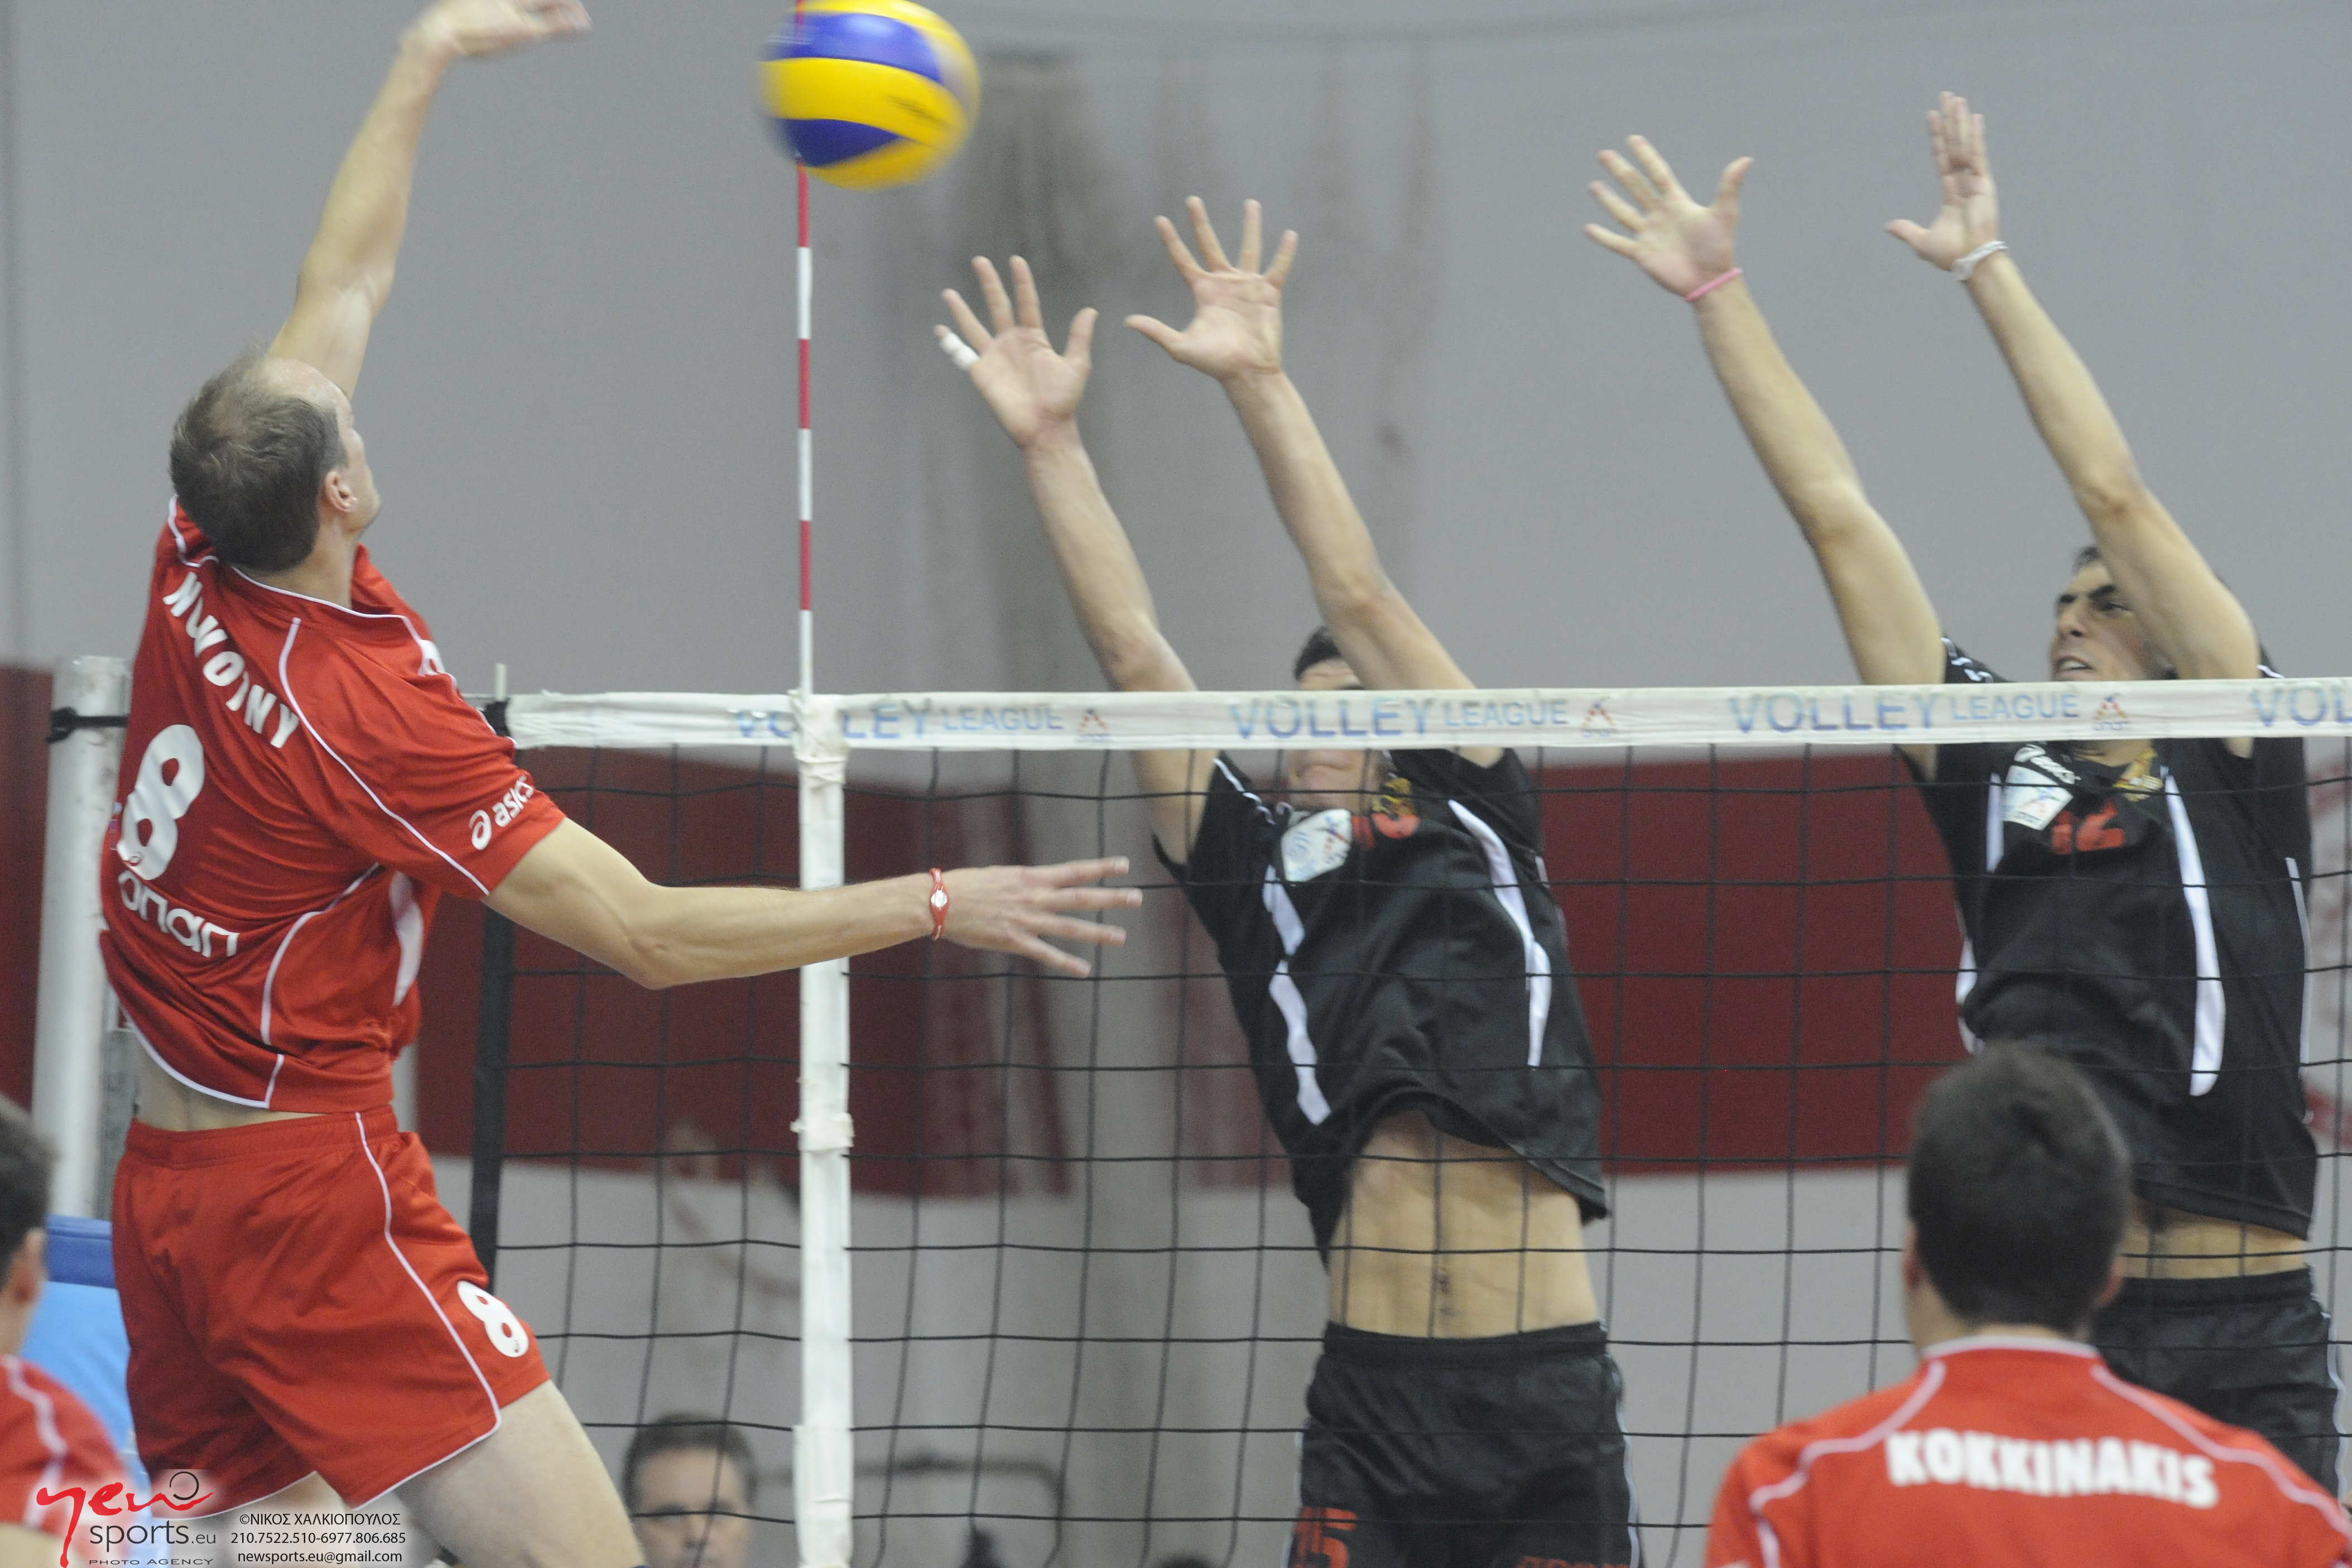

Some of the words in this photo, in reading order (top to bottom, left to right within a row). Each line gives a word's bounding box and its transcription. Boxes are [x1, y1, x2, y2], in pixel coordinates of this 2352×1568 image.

[729, 698, 931, 739] VOLEY
[942, 706, 1064, 732] LEAGUE
[1229, 696, 1435, 739] VOLLEY
[1444, 700, 1568, 727] LEAGUE
[1730, 690, 1938, 733] VOLLEY
[1952, 694, 2080, 720] LEAGUE
[116, 724, 205, 880] 8
[492, 775, 534, 828] asics
[456, 1280, 529, 1357] 8
[1885, 1427, 2220, 1509] KOKKINAKIS
